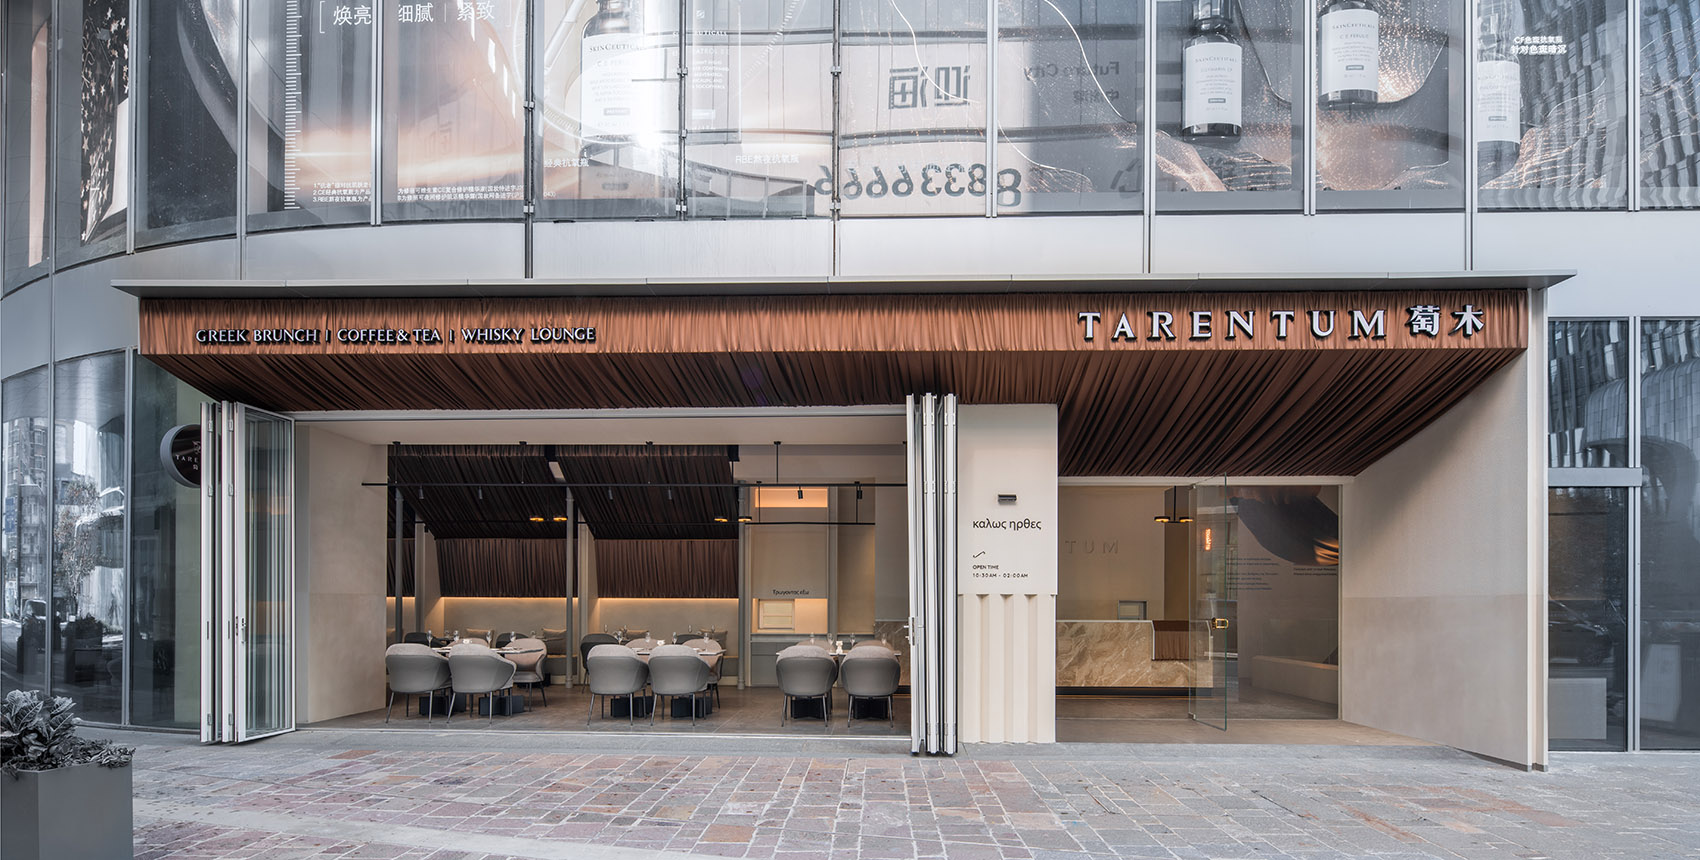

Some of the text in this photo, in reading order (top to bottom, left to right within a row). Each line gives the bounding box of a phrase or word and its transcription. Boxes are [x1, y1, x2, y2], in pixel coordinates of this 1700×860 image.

[333, 1, 495, 25] 焕亮 细腻 紧致
[1078, 304, 1485, 340] TARENTUM 萄木
[195, 329, 248, 342] GREEK
[253, 329, 318, 342] BRUNCH
[337, 328, 395, 342] COFFEE
[412, 328, 441, 342] TEA
[460, 327, 524, 342] WHISKY
[530, 327, 596, 341] LOUNGE
[972, 518, 1042, 531] καλως ηρθες
